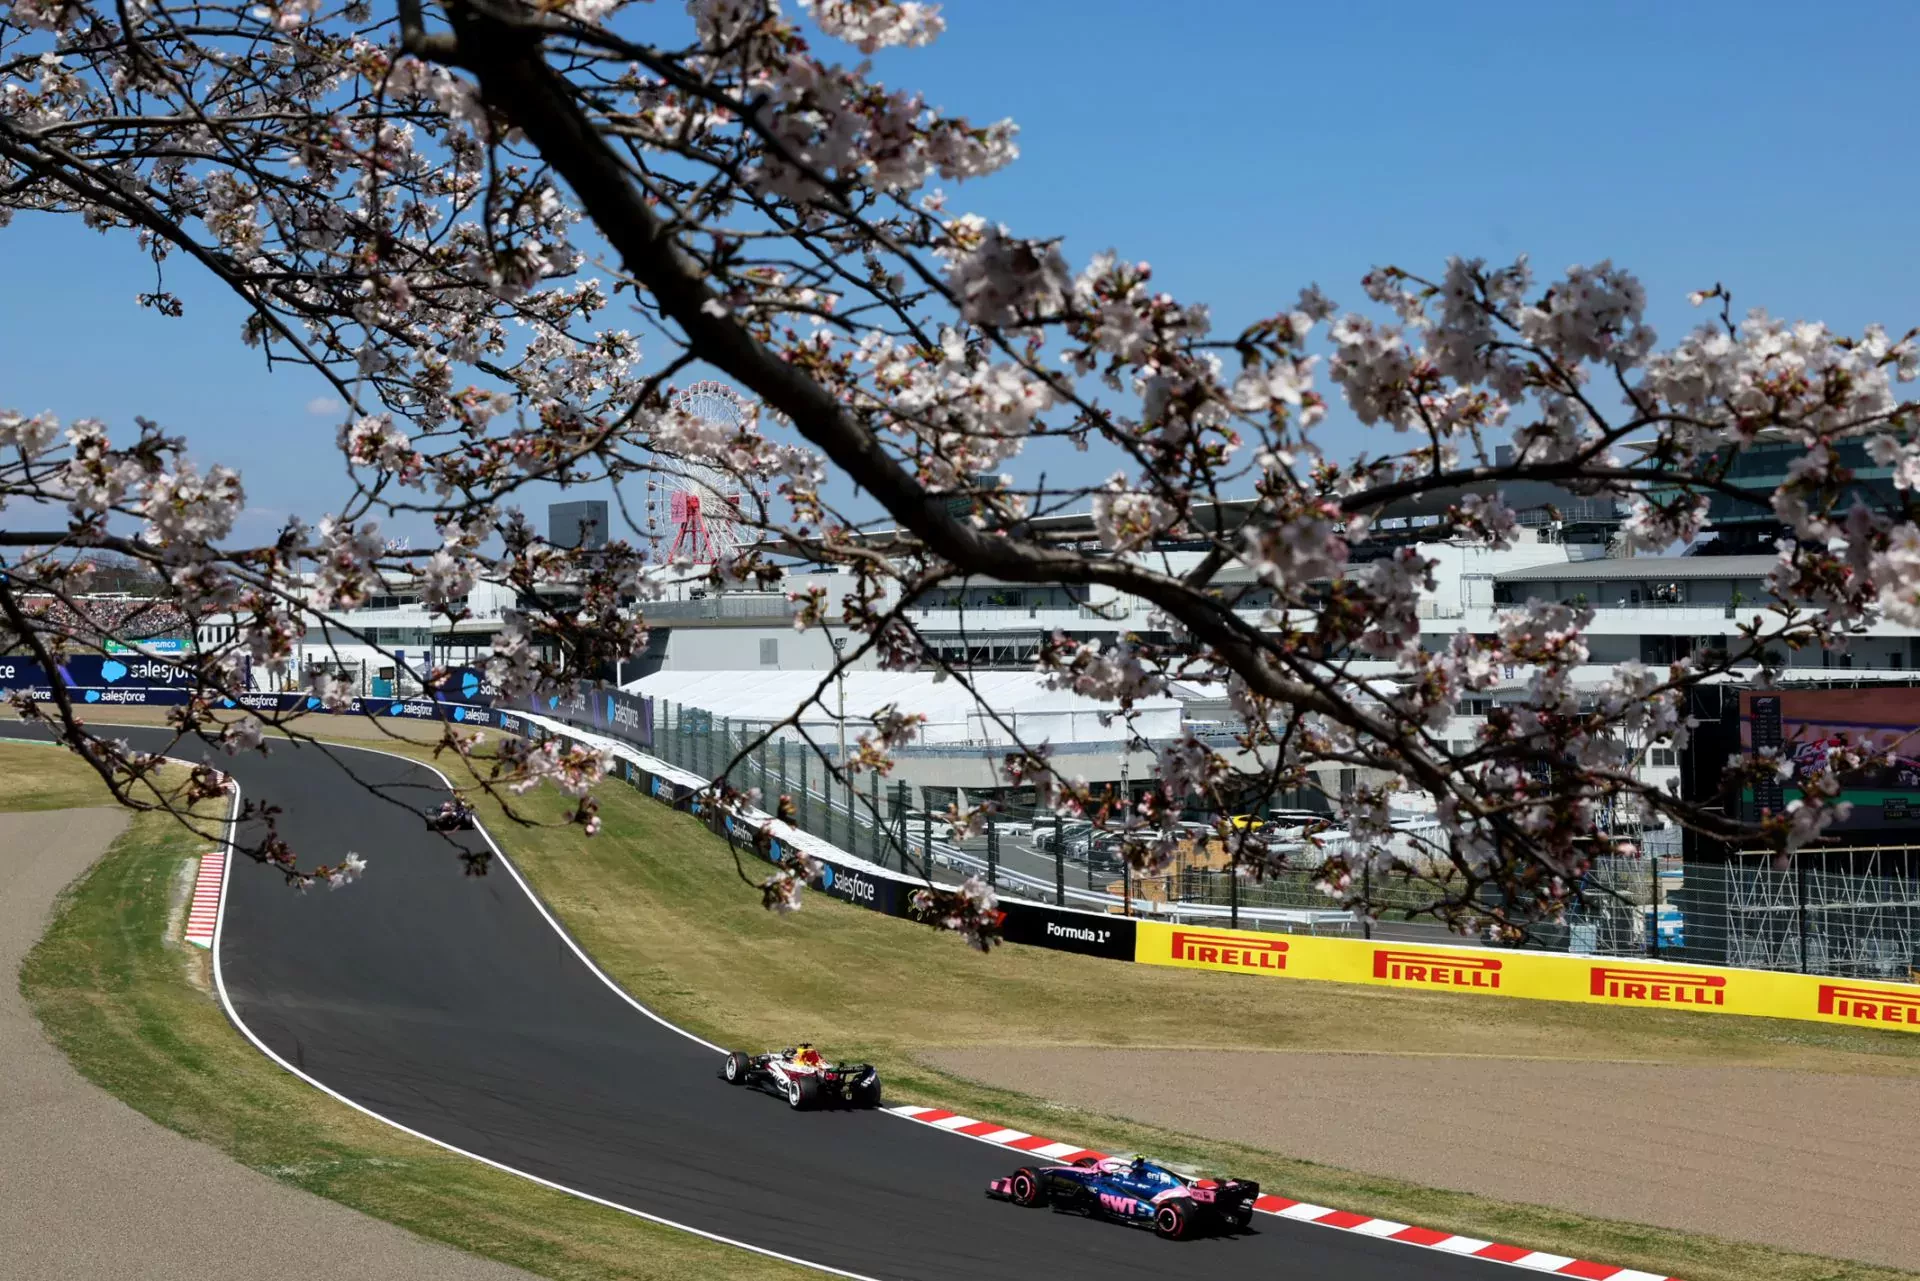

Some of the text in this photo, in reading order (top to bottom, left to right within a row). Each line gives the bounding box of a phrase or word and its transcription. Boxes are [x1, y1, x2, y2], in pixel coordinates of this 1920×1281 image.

[130, 660, 198, 683] salesfor
[101, 690, 146, 704] salesforce
[240, 694, 278, 709] salesforce
[403, 702, 433, 717] salesforce
[1047, 922, 1095, 942] Formula
[1171, 932, 1289, 970] PIRELLI
[1373, 950, 1503, 988] PIRELLI
[1590, 967, 1727, 1006] PIRELLI
[1100, 1192, 1138, 1215] BWT
